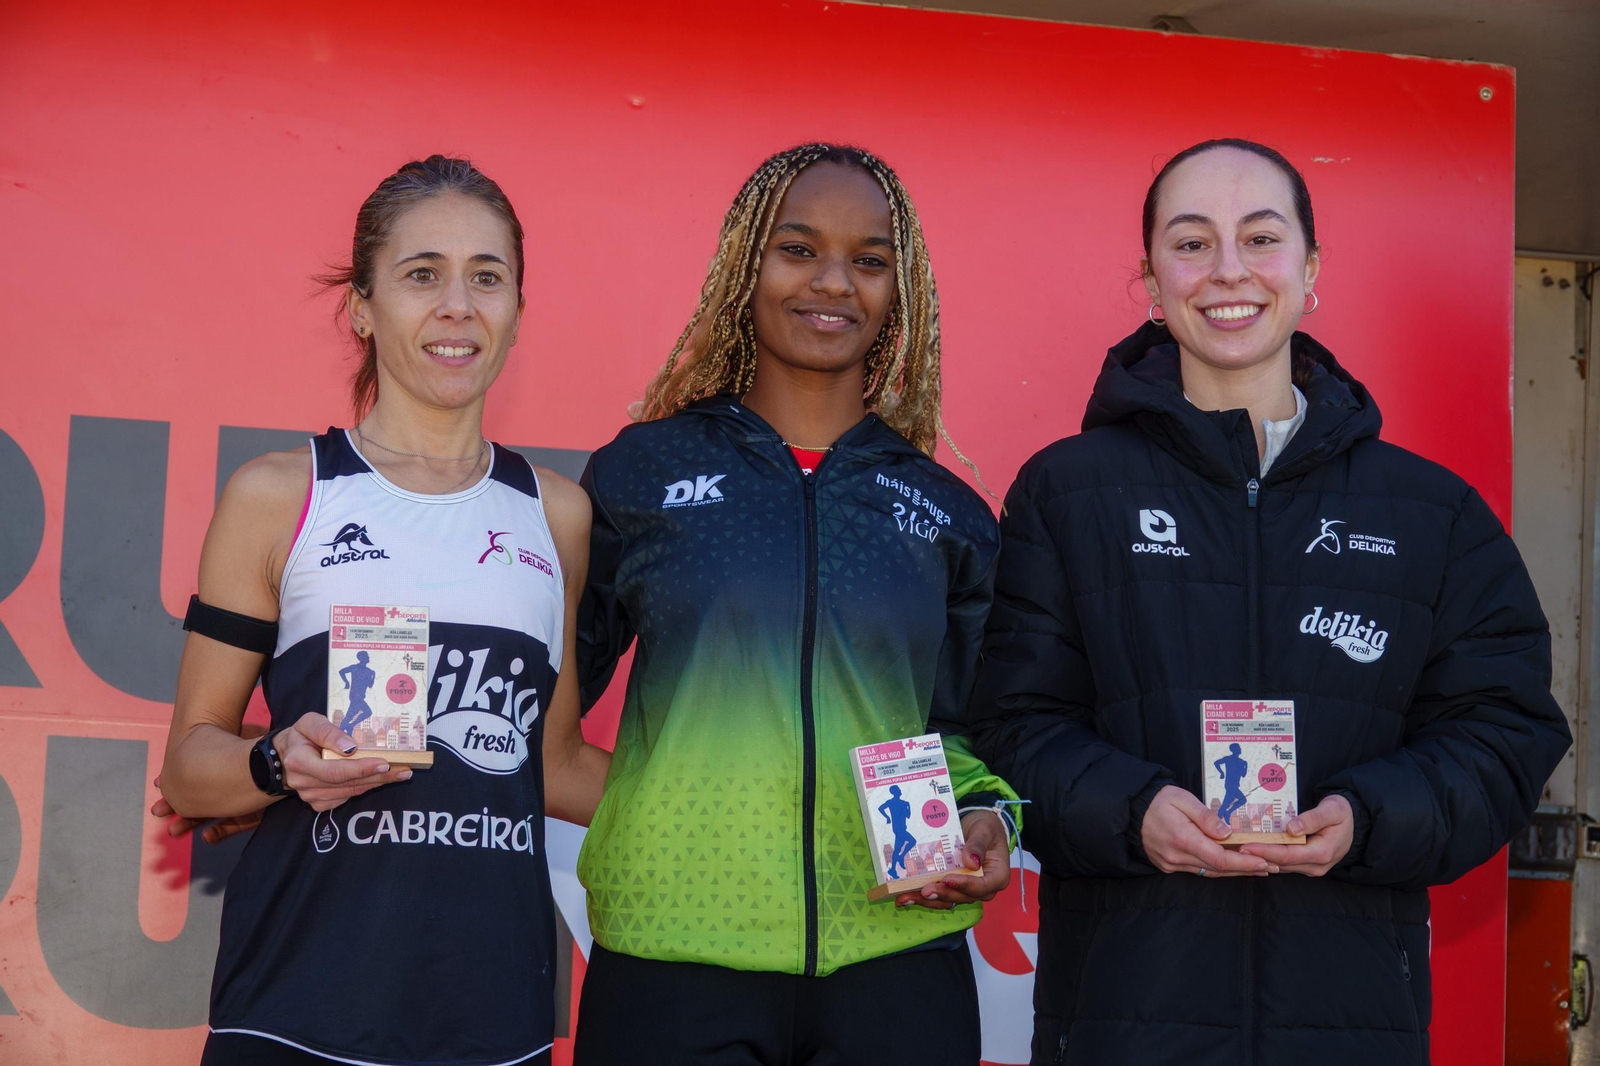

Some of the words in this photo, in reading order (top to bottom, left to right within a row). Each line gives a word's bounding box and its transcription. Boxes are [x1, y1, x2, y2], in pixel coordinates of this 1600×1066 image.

[662, 474, 727, 504] DK
[662, 498, 724, 509] SPORTSWEAR
[876, 473, 911, 498] máis
[922, 498, 951, 525] auga
[1365, 535, 1396, 545] DEPORTIVO
[1349, 540, 1396, 556] DELIKIA
[519, 554, 554, 578] DELIKIA
[334, 607, 352, 615] MILLA
[334, 615, 355, 623] CIDADE
[365, 616, 380, 624] VIGO
[1300, 606, 1389, 650] delikia
[1348, 642, 1370, 655] fresh
[463, 725, 516, 754] fresh
[860, 748, 876, 756] MILLA
[861, 755, 880, 763] CIDADE
[888, 750, 901, 758] VIGO
